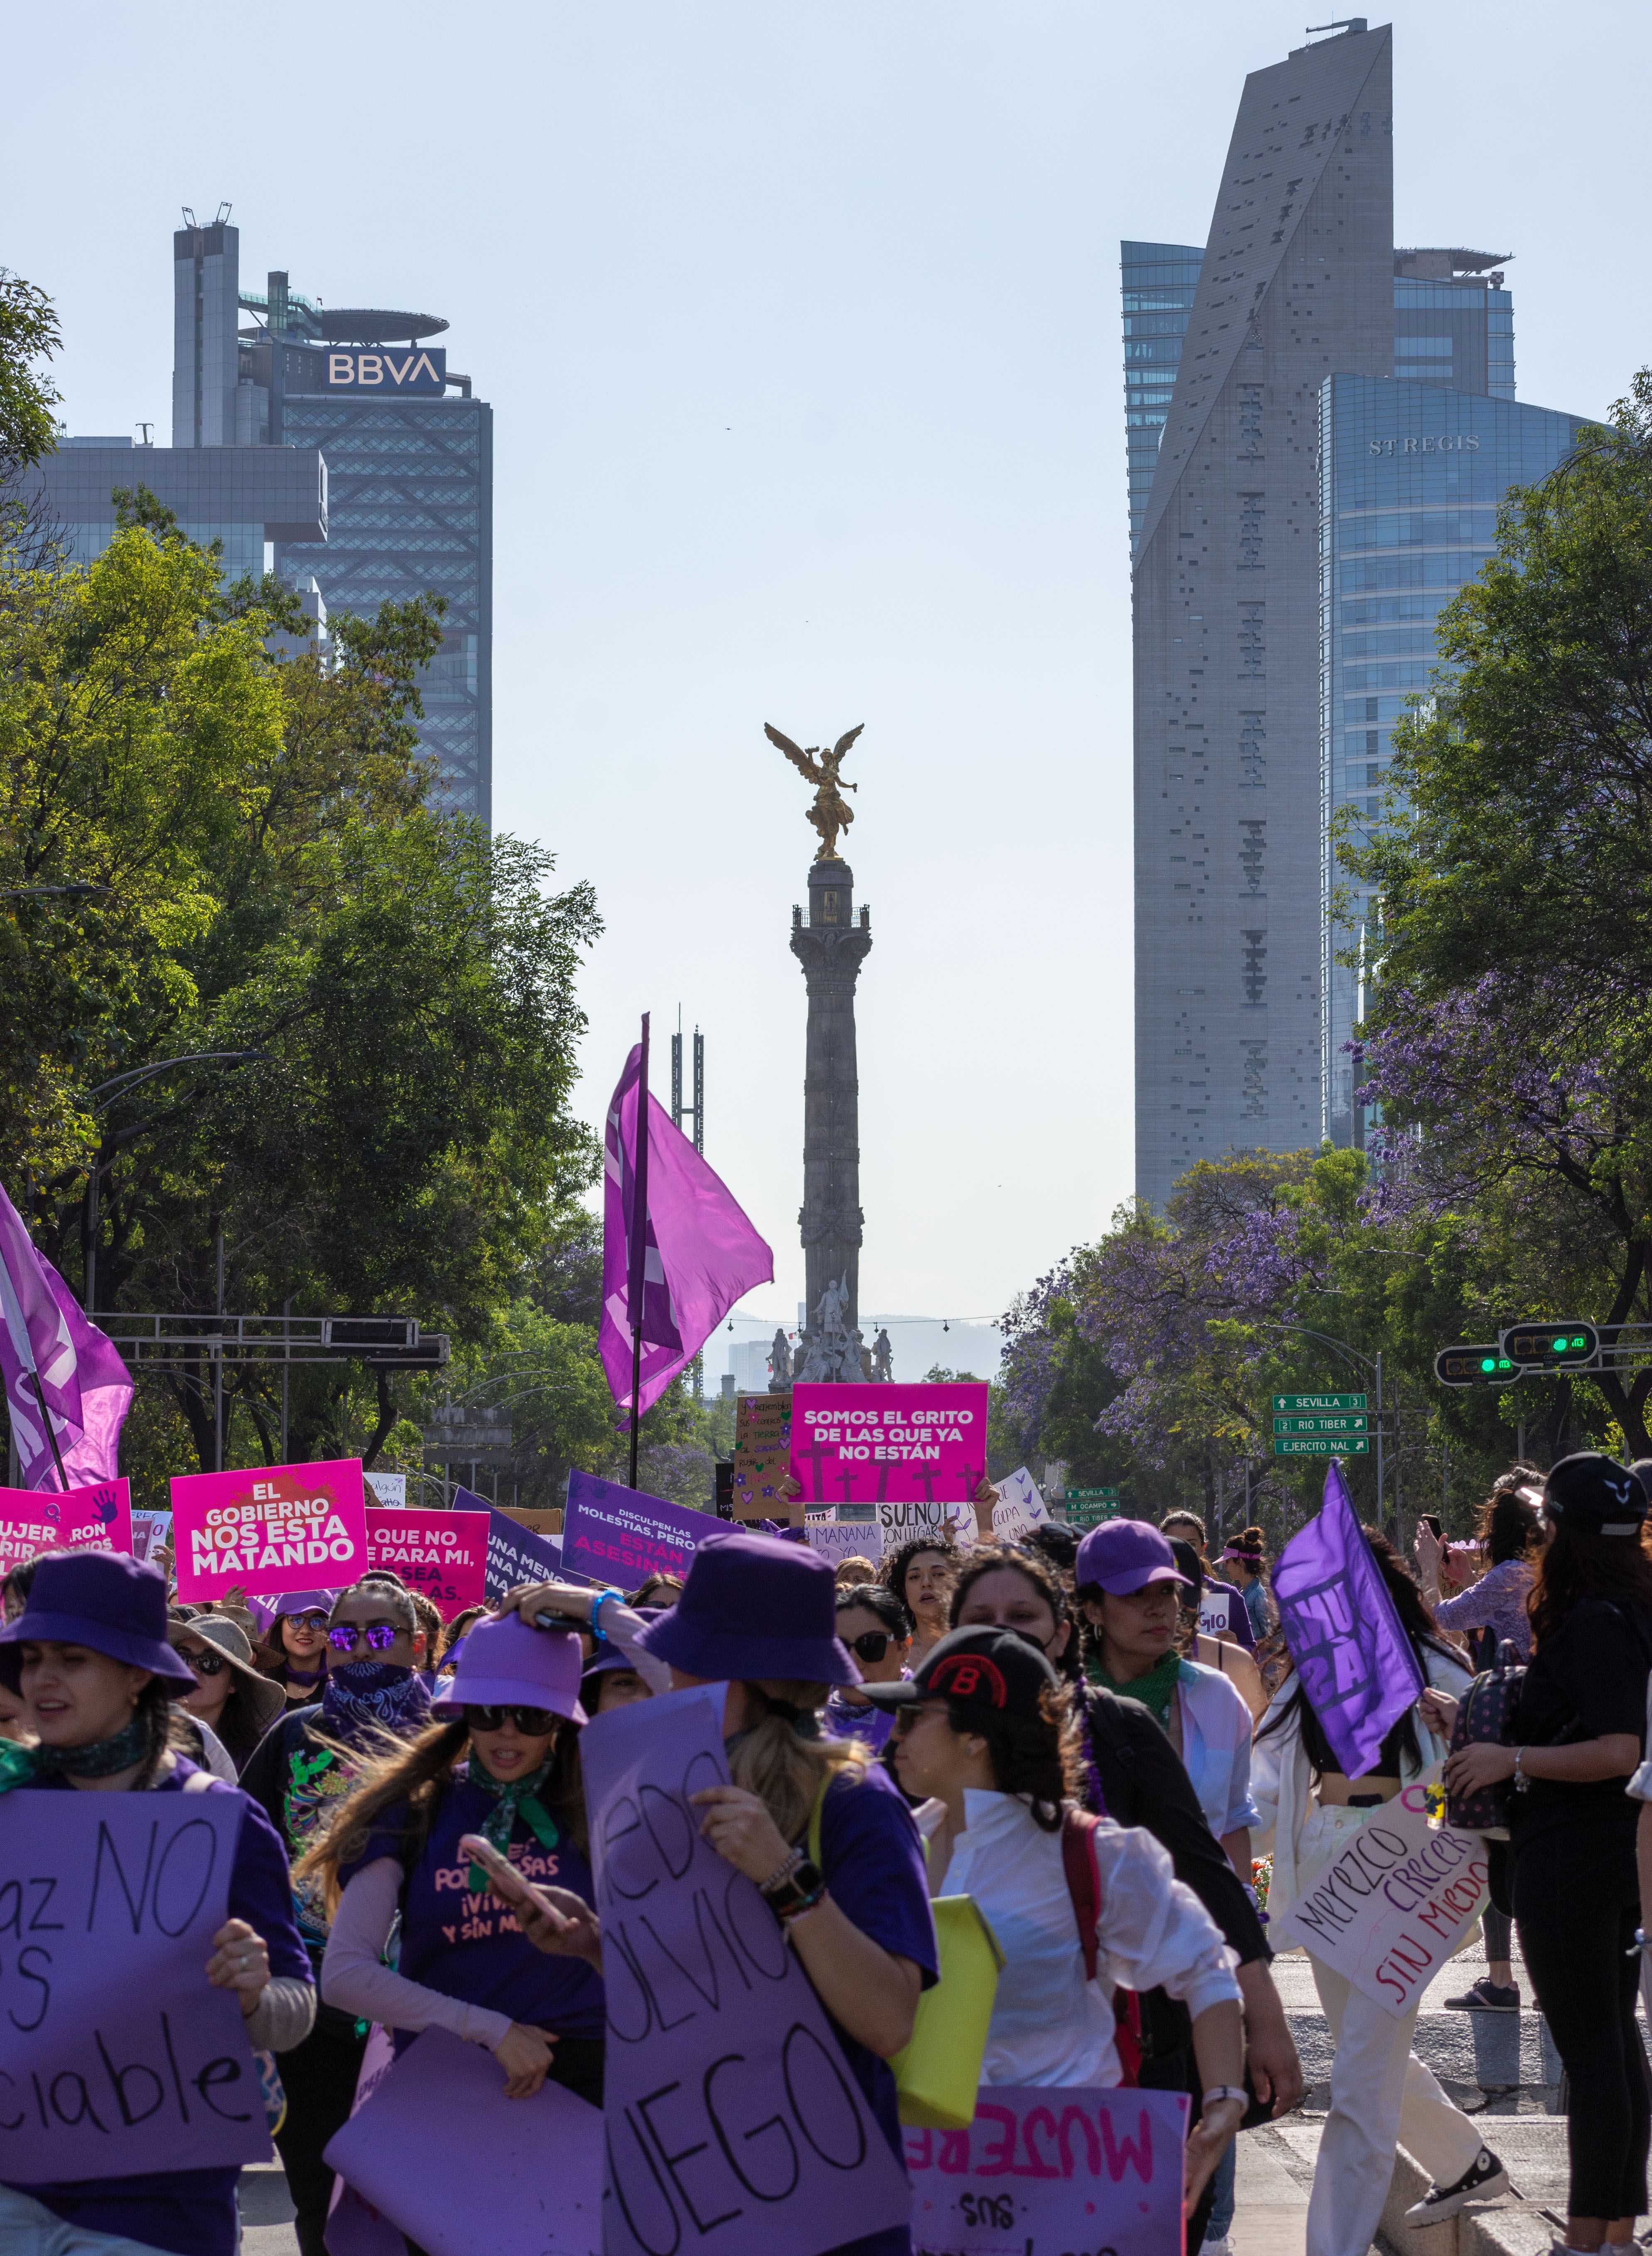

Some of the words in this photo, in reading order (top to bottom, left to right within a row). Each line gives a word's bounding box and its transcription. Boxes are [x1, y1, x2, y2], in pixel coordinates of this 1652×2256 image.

[329, 352, 440, 385] BBVA
[1404, 435, 1480, 453] REGIS
[1296, 1398, 1340, 1407] SEVILLA
[804, 1411, 879, 1424] SOMOS
[883, 1411, 907, 1424] EL
[911, 1411, 973, 1424] GRITO
[1299, 1420, 1314, 1429] RIO
[1319, 1420, 1347, 1429] TIBER
[814, 1428, 841, 1441] DE
[846, 1428, 884, 1441] LAS
[889, 1428, 932, 1443] QUE
[935, 1428, 963, 1441] YA
[839, 1446, 870, 1460] NO
[875, 1442, 939, 1460] ESTÁN
[1283, 1442, 1326, 1451] EJERCITO
[1331, 1442, 1349, 1450] NAL
[253, 1483, 280, 1500] EL
[206, 1498, 329, 1526] GOBIERNO
[993, 1506, 1020, 1526] CULPA
[70, 1522, 106, 1542] RON
[191, 1523, 259, 1552] NOS
[267, 1515, 348, 1543] ESTA
[578, 1504, 654, 1538] MOLESTIAS,
[657, 1531, 696, 1551] PERO
[619, 1509, 671, 1531] DISCULPEN
[673, 1527, 691, 1538] LAS
[374, 1529, 420, 1544] QUE
[425, 1531, 457, 1546] NO
[816, 1526, 875, 1544] MAÑANA
[193, 1538, 354, 1575] MATANDO
[381, 1547, 440, 1563] PARA
[445, 1550, 474, 1567] MI,
[620, 1533, 683, 1564] ESTÁN
[401, 1566, 442, 1581] SEA
[520, 1553, 568, 1585] MENO
[485, 1569, 509, 1593] NA
[87, 1819, 216, 1937] NO
[601, 2022, 866, 2256] UEGO
